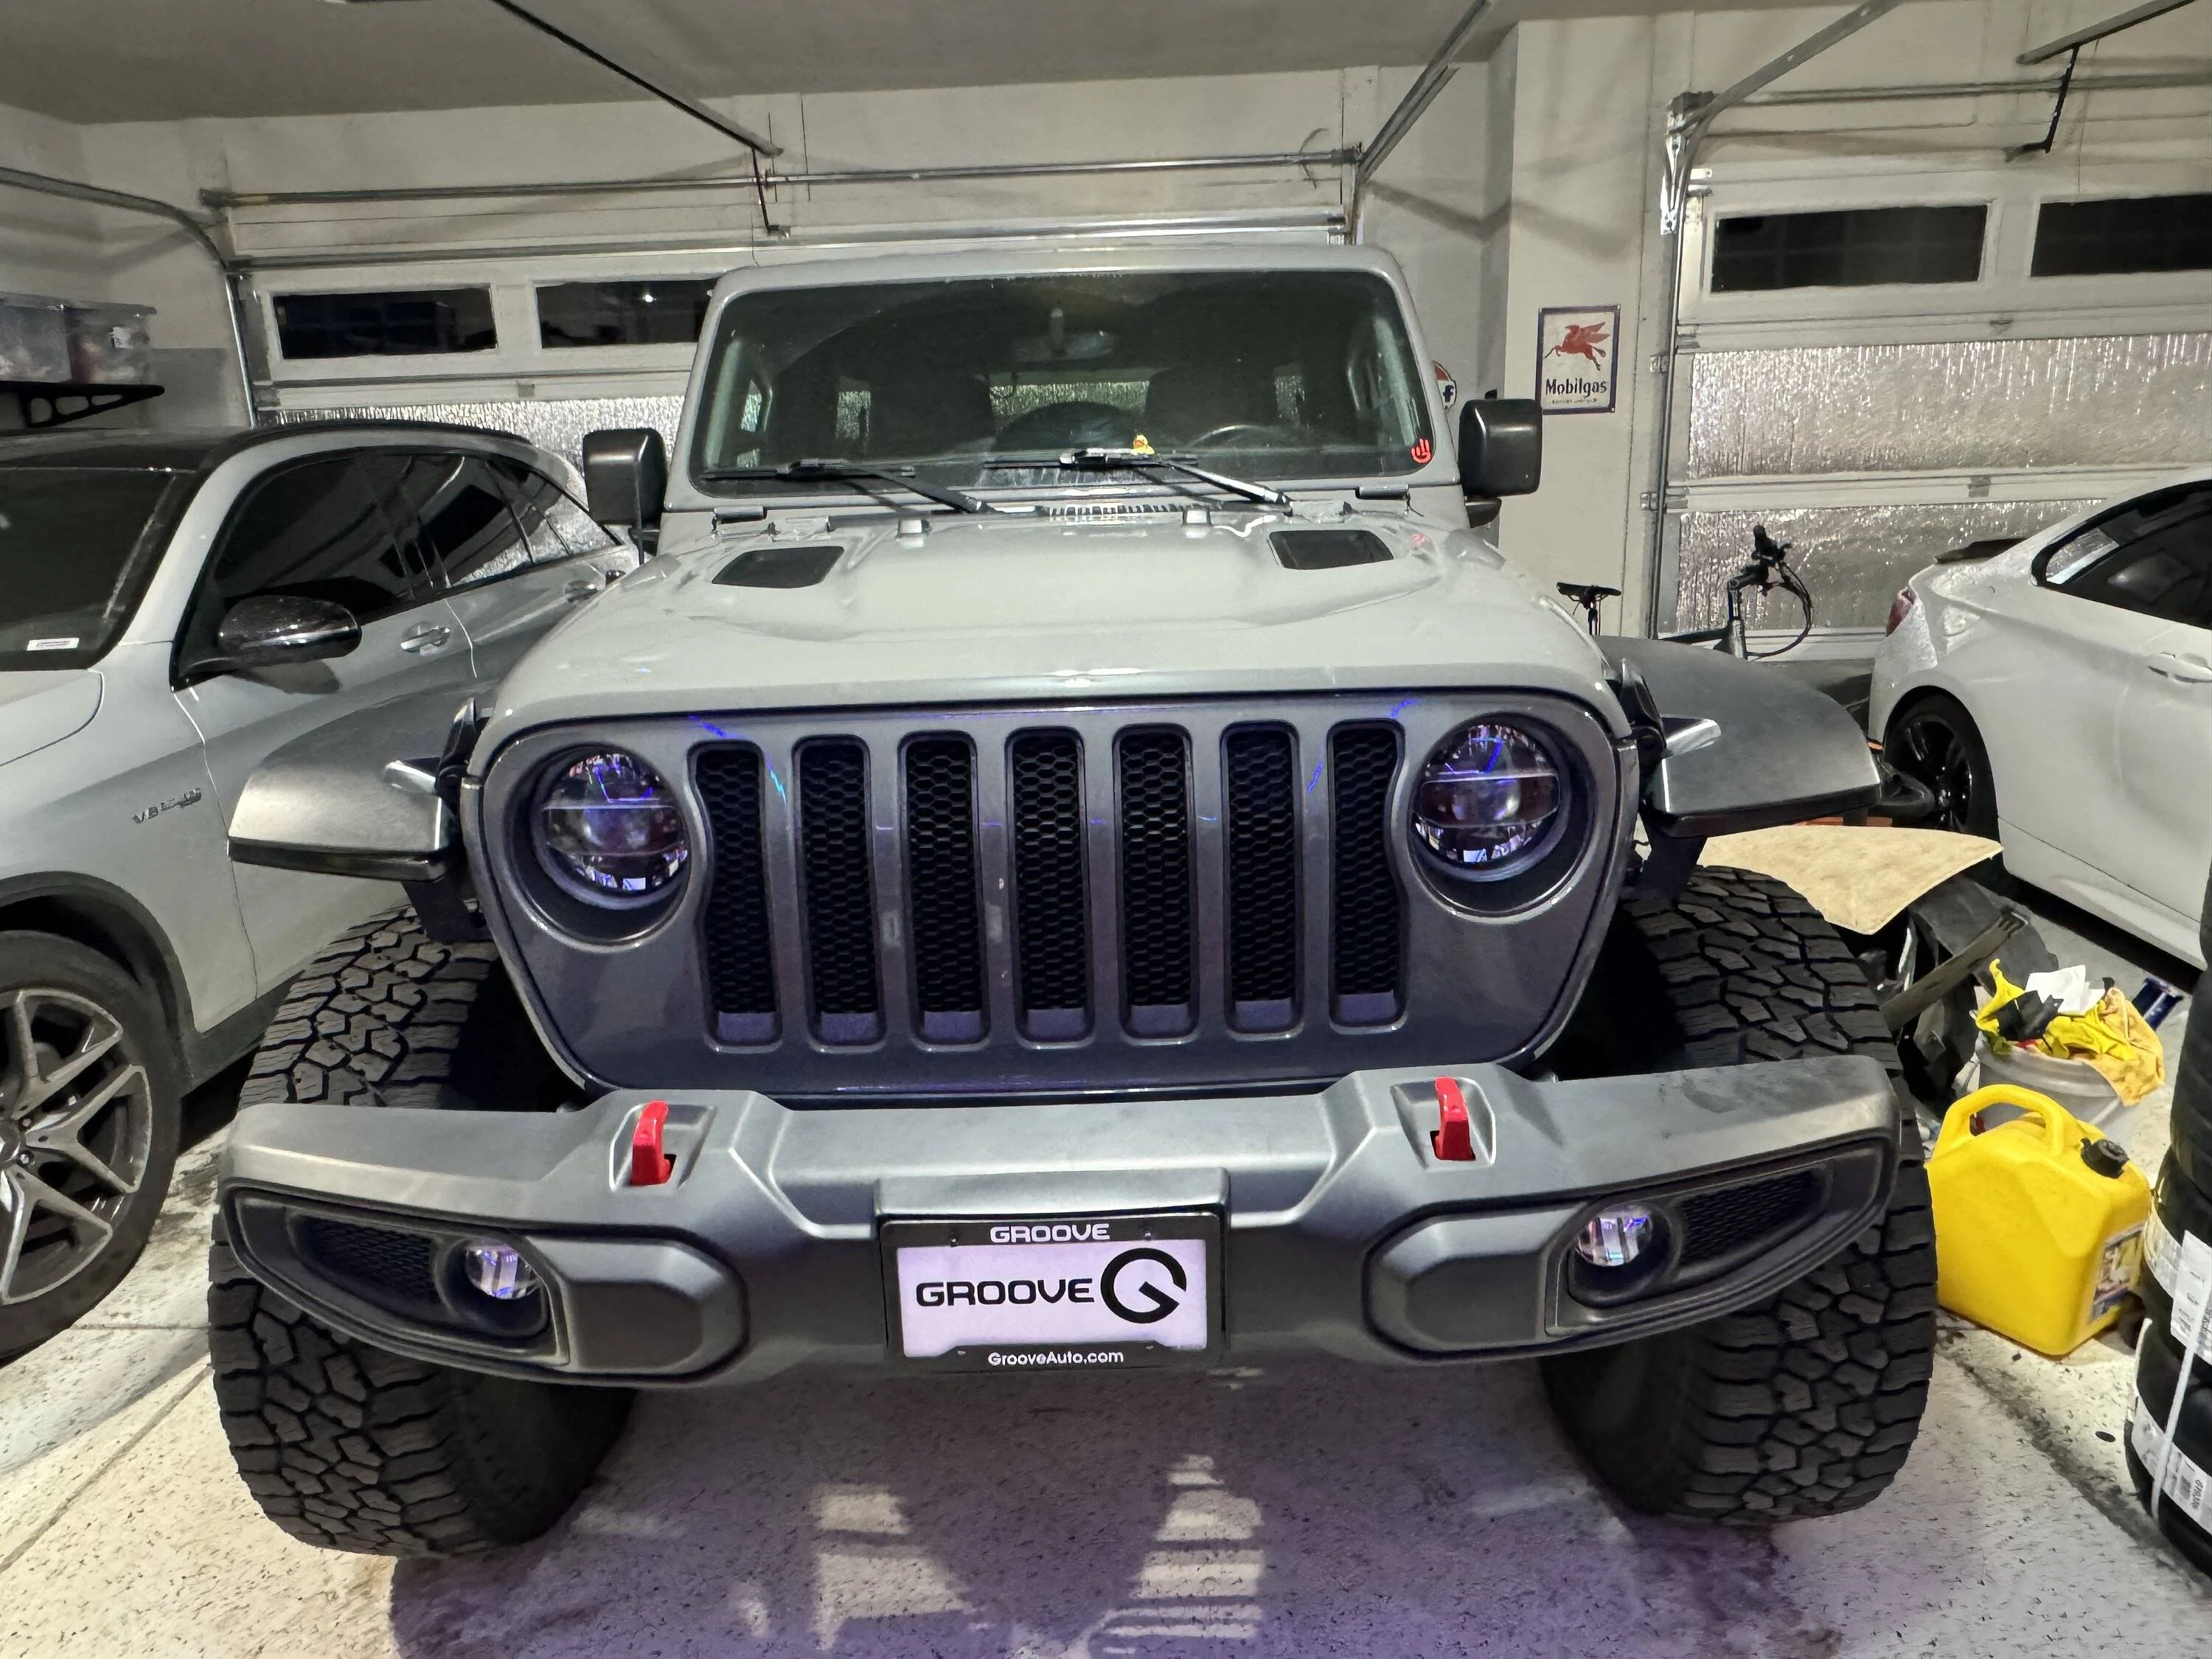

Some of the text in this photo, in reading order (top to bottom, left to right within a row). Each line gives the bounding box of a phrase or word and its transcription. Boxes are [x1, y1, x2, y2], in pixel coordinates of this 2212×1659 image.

[1545, 377, 1607, 398] Mobilgas
[990, 1223, 1110, 1243] GROOVE
[916, 1278, 1095, 1307] GROOVE
[988, 1351, 1124, 1366] GrooveAuto.com
